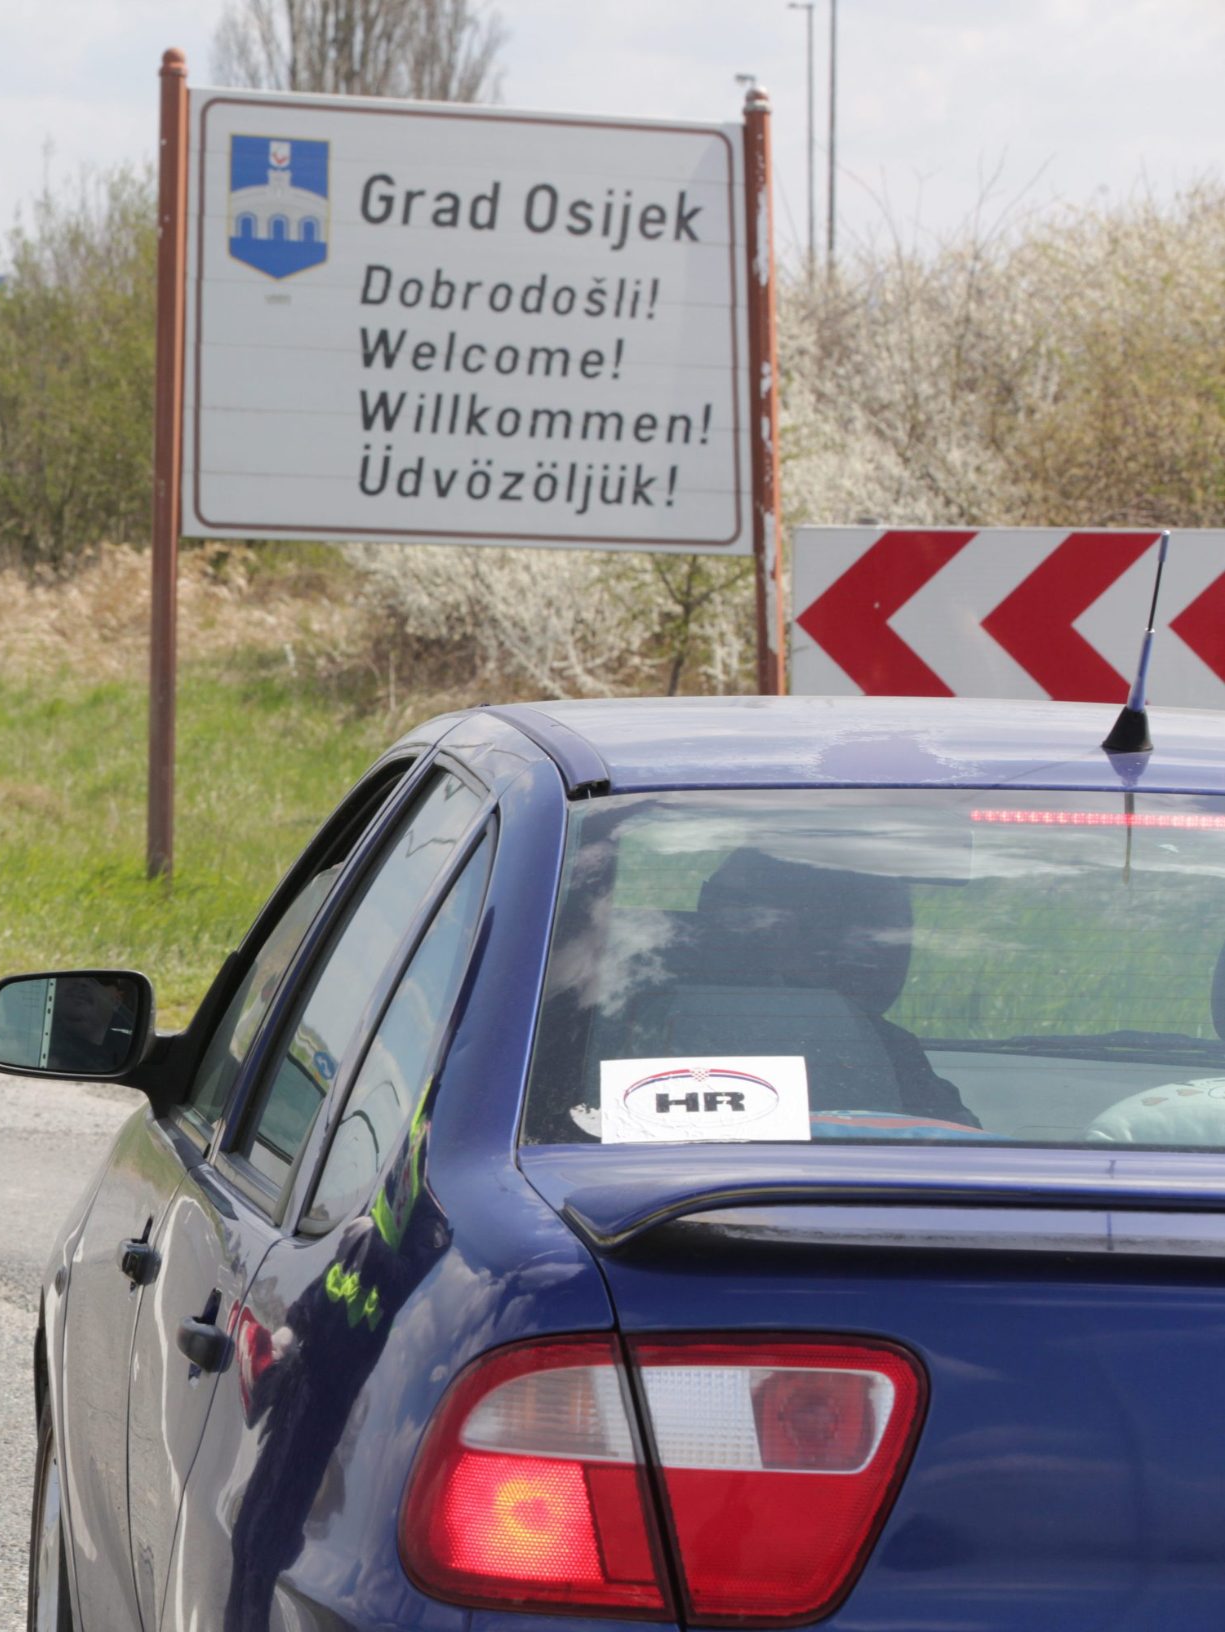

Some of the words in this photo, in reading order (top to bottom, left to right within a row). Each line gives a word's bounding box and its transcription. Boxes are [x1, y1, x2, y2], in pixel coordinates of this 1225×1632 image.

[361, 173, 501, 230] Grad
[524, 183, 704, 252] Osijek
[360, 264, 659, 320] Dobrodošli!
[360, 327, 624, 380] Welcome!
[359, 389, 712, 445] Willkommen!
[358, 443, 677, 515] Üdvözöljük!
[655, 1091, 746, 1113] HR
